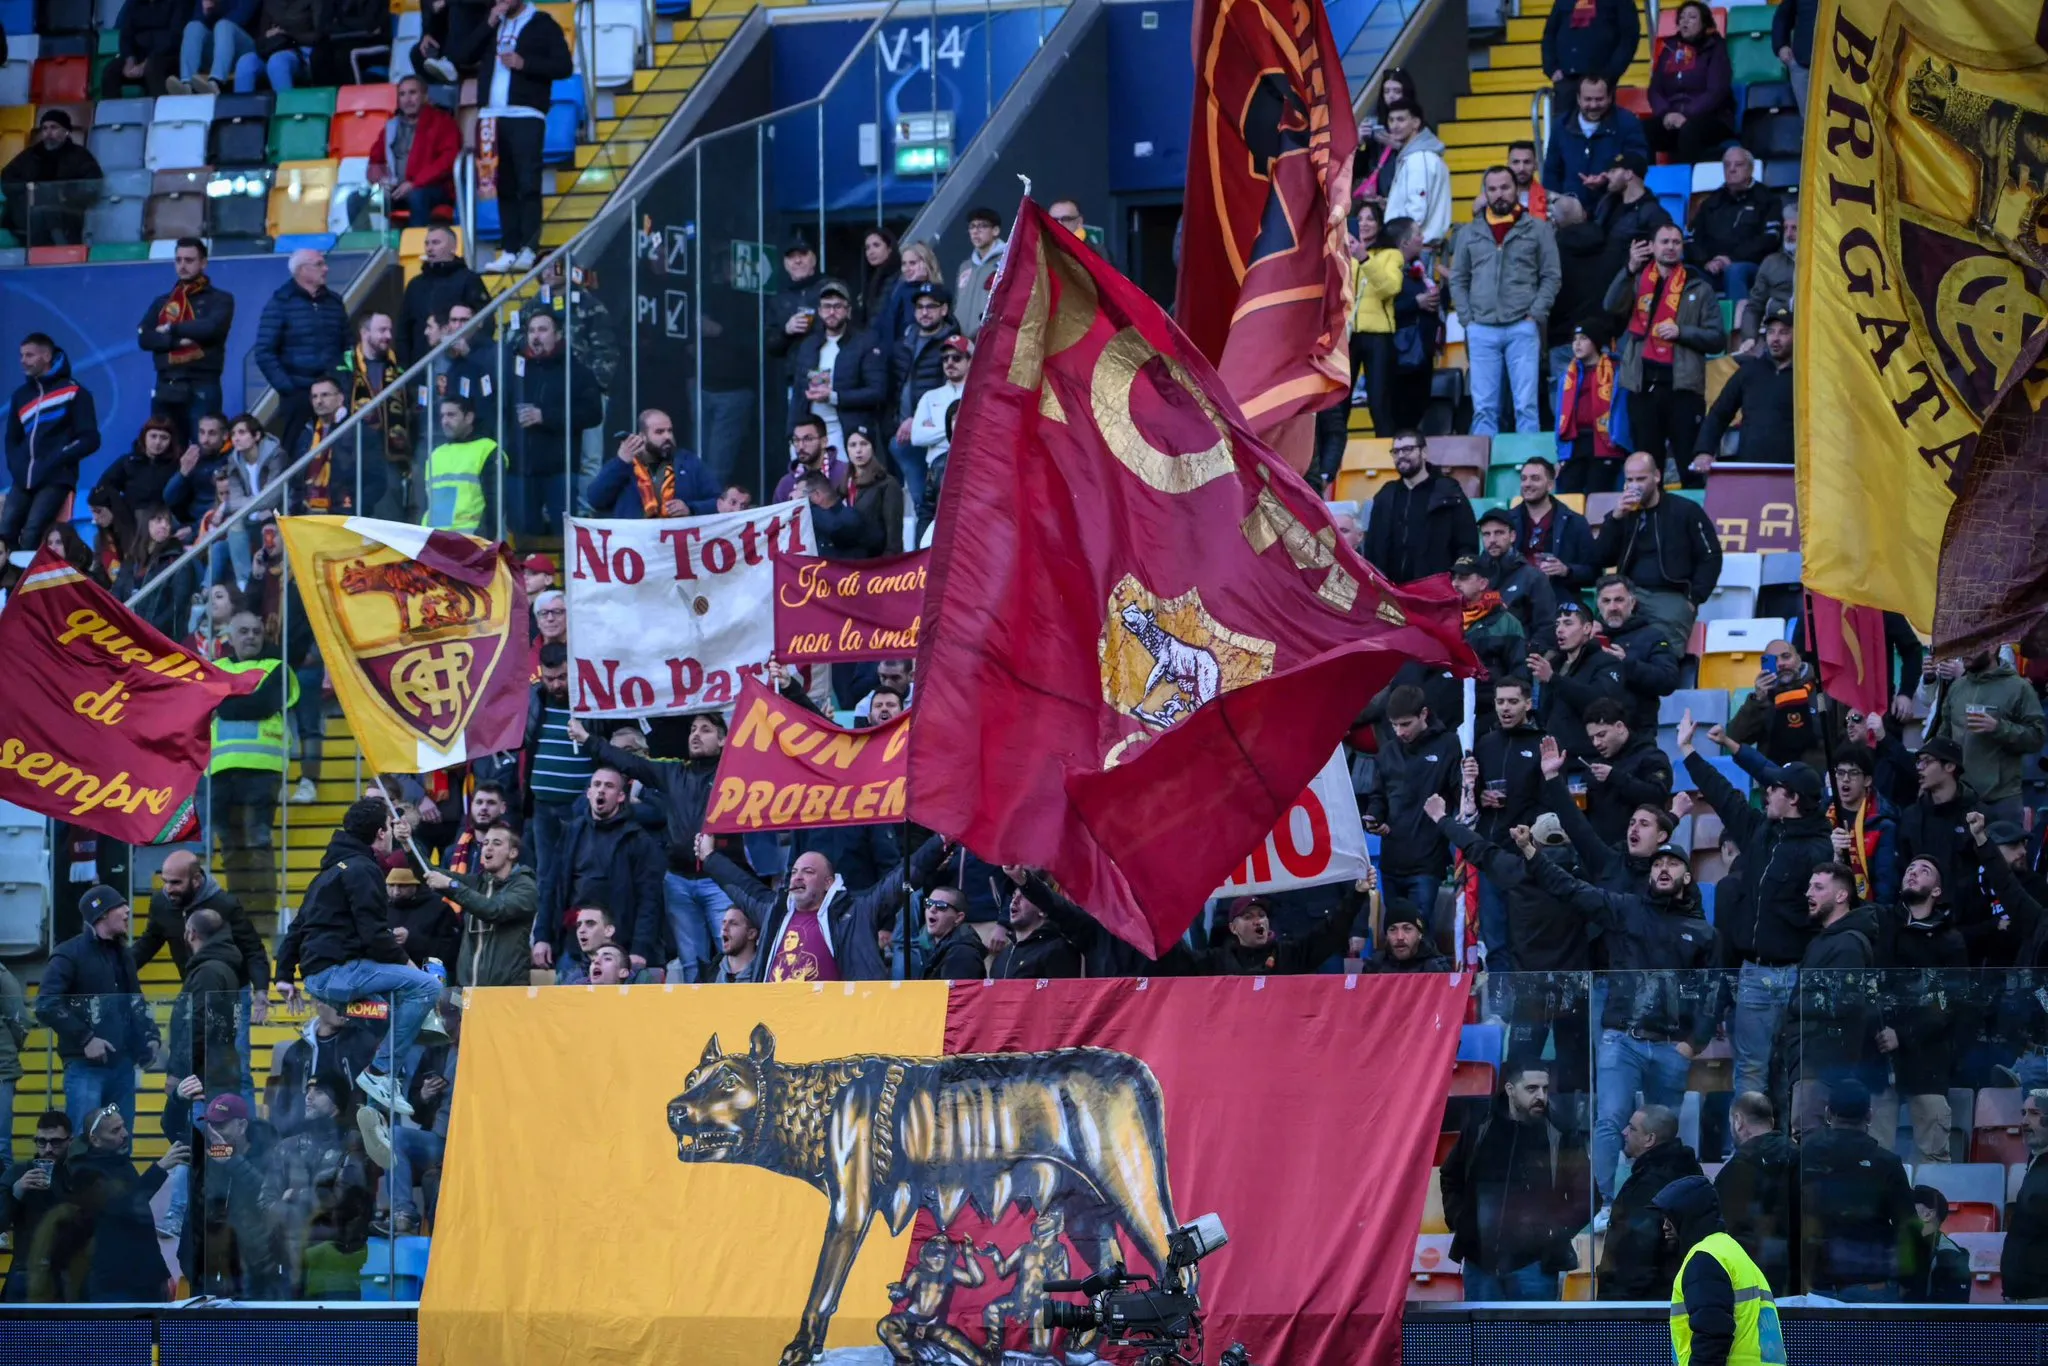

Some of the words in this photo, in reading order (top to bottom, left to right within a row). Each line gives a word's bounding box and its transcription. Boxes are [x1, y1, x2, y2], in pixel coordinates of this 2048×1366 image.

[879, 25, 965, 72] V14
[638, 229, 660, 260] P2
[1827, 5, 1981, 500] BRIGATA
[638, 295, 657, 325] P1
[573, 525, 645, 585] No
[660, 505, 806, 581] Totti
[837, 571, 861, 597] di
[867, 565, 927, 595] amar
[788, 633, 832, 654] non
[838, 618, 863, 652] la
[869, 615, 921, 650] smet
[73, 680, 130, 725] di
[574, 657, 655, 712] No
[732, 698, 871, 769] NUN
[0, 738, 173, 816] sempre
[346, 1002, 379, 1016] ROMA
